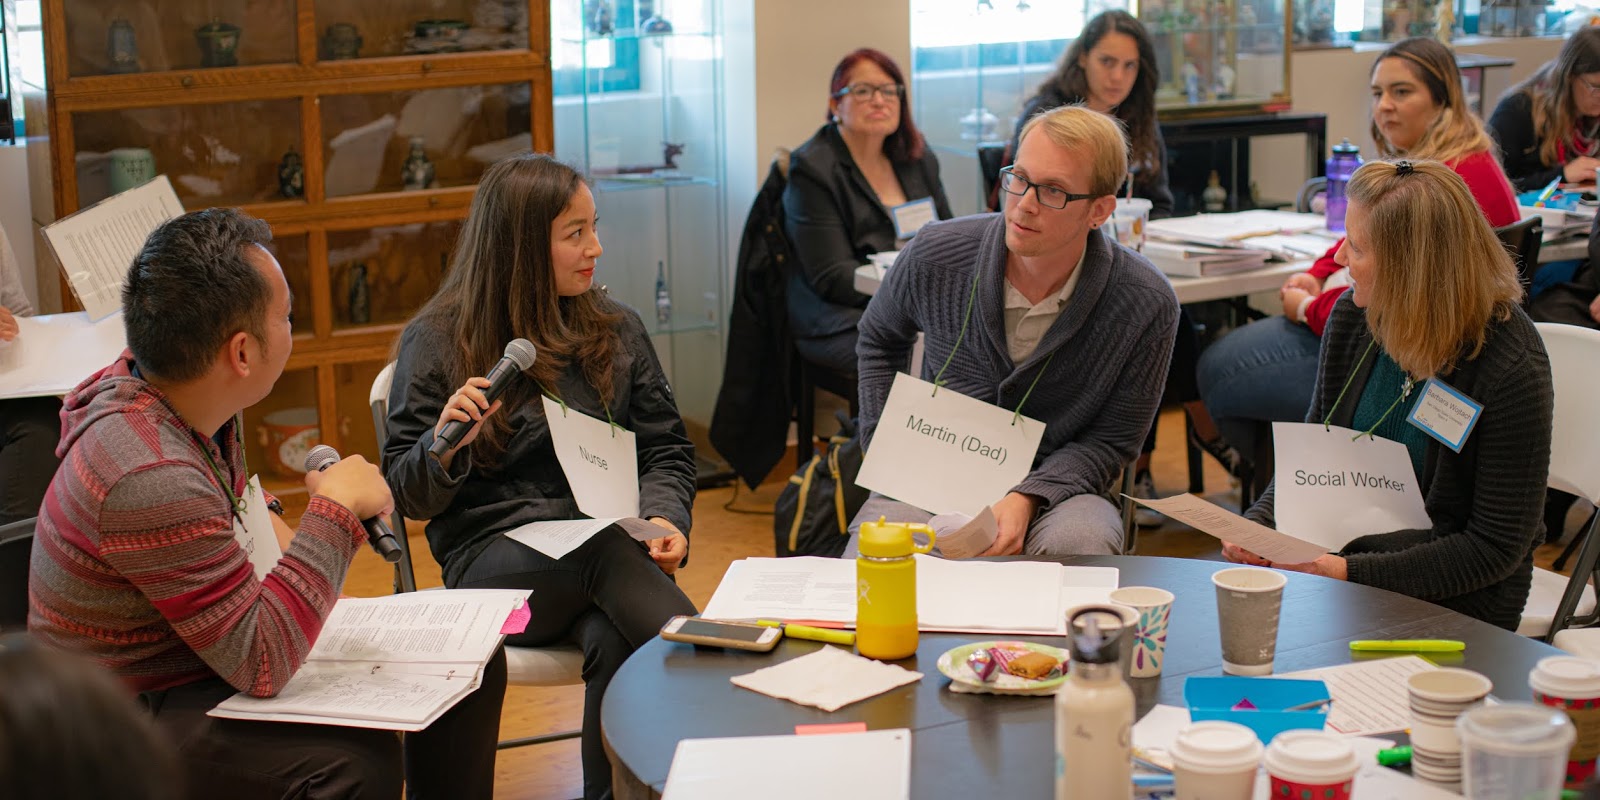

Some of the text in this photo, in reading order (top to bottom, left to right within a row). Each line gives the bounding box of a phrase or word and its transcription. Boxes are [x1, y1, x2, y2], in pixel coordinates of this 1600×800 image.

[1426, 388, 1449, 406] Barbara
[1449, 402, 1472, 421] Wojtach
[906, 414, 1008, 466] Martin (Dad)
[579, 444, 608, 470] Nurse
[1295, 469, 1405, 493] Social Worker
